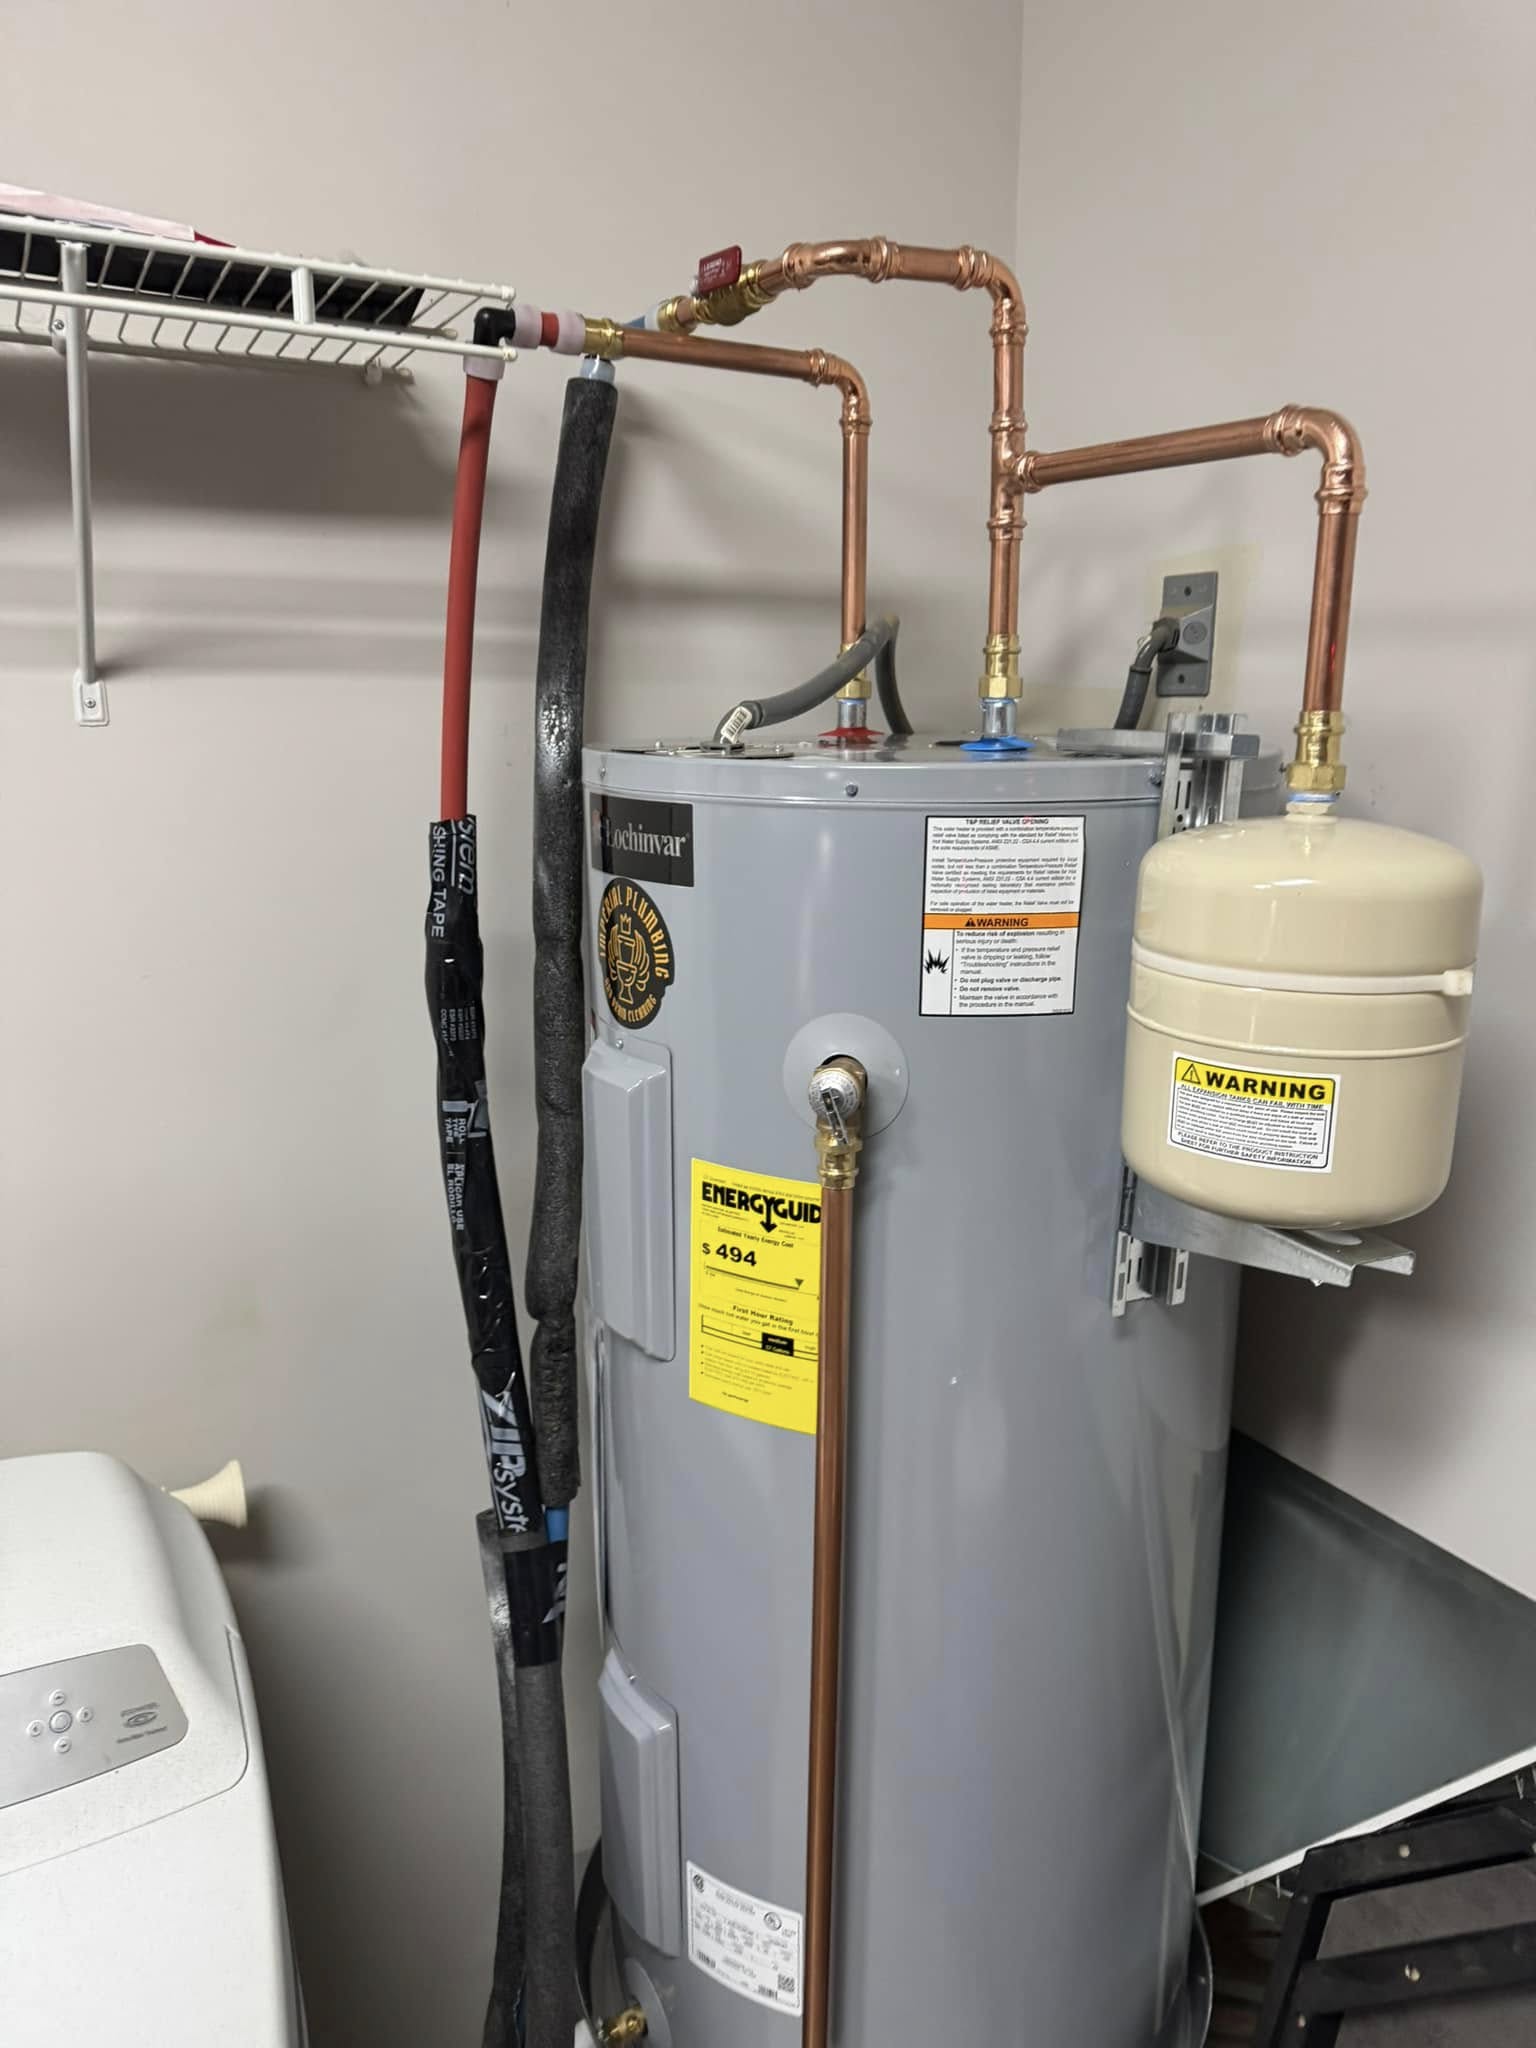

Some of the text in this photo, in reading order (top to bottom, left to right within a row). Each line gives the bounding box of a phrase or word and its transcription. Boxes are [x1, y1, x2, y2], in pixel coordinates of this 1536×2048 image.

[606, 820, 686, 858] Lochinvar
[431, 888, 446, 938] TAPE
[976, 918, 1028, 926] WARNING
[599, 886, 670, 979] IMPERIAL PLUMBING
[1206, 1071, 1326, 1099] WARNING
[445, 1117, 453, 1143] TAPE
[702, 1182, 822, 1223] ENERGYGUID
[702, 1243, 758, 1266] $ 494
[732, 1306, 794, 1325] First Hour Rating
[482, 1390, 527, 1476] ZIP
